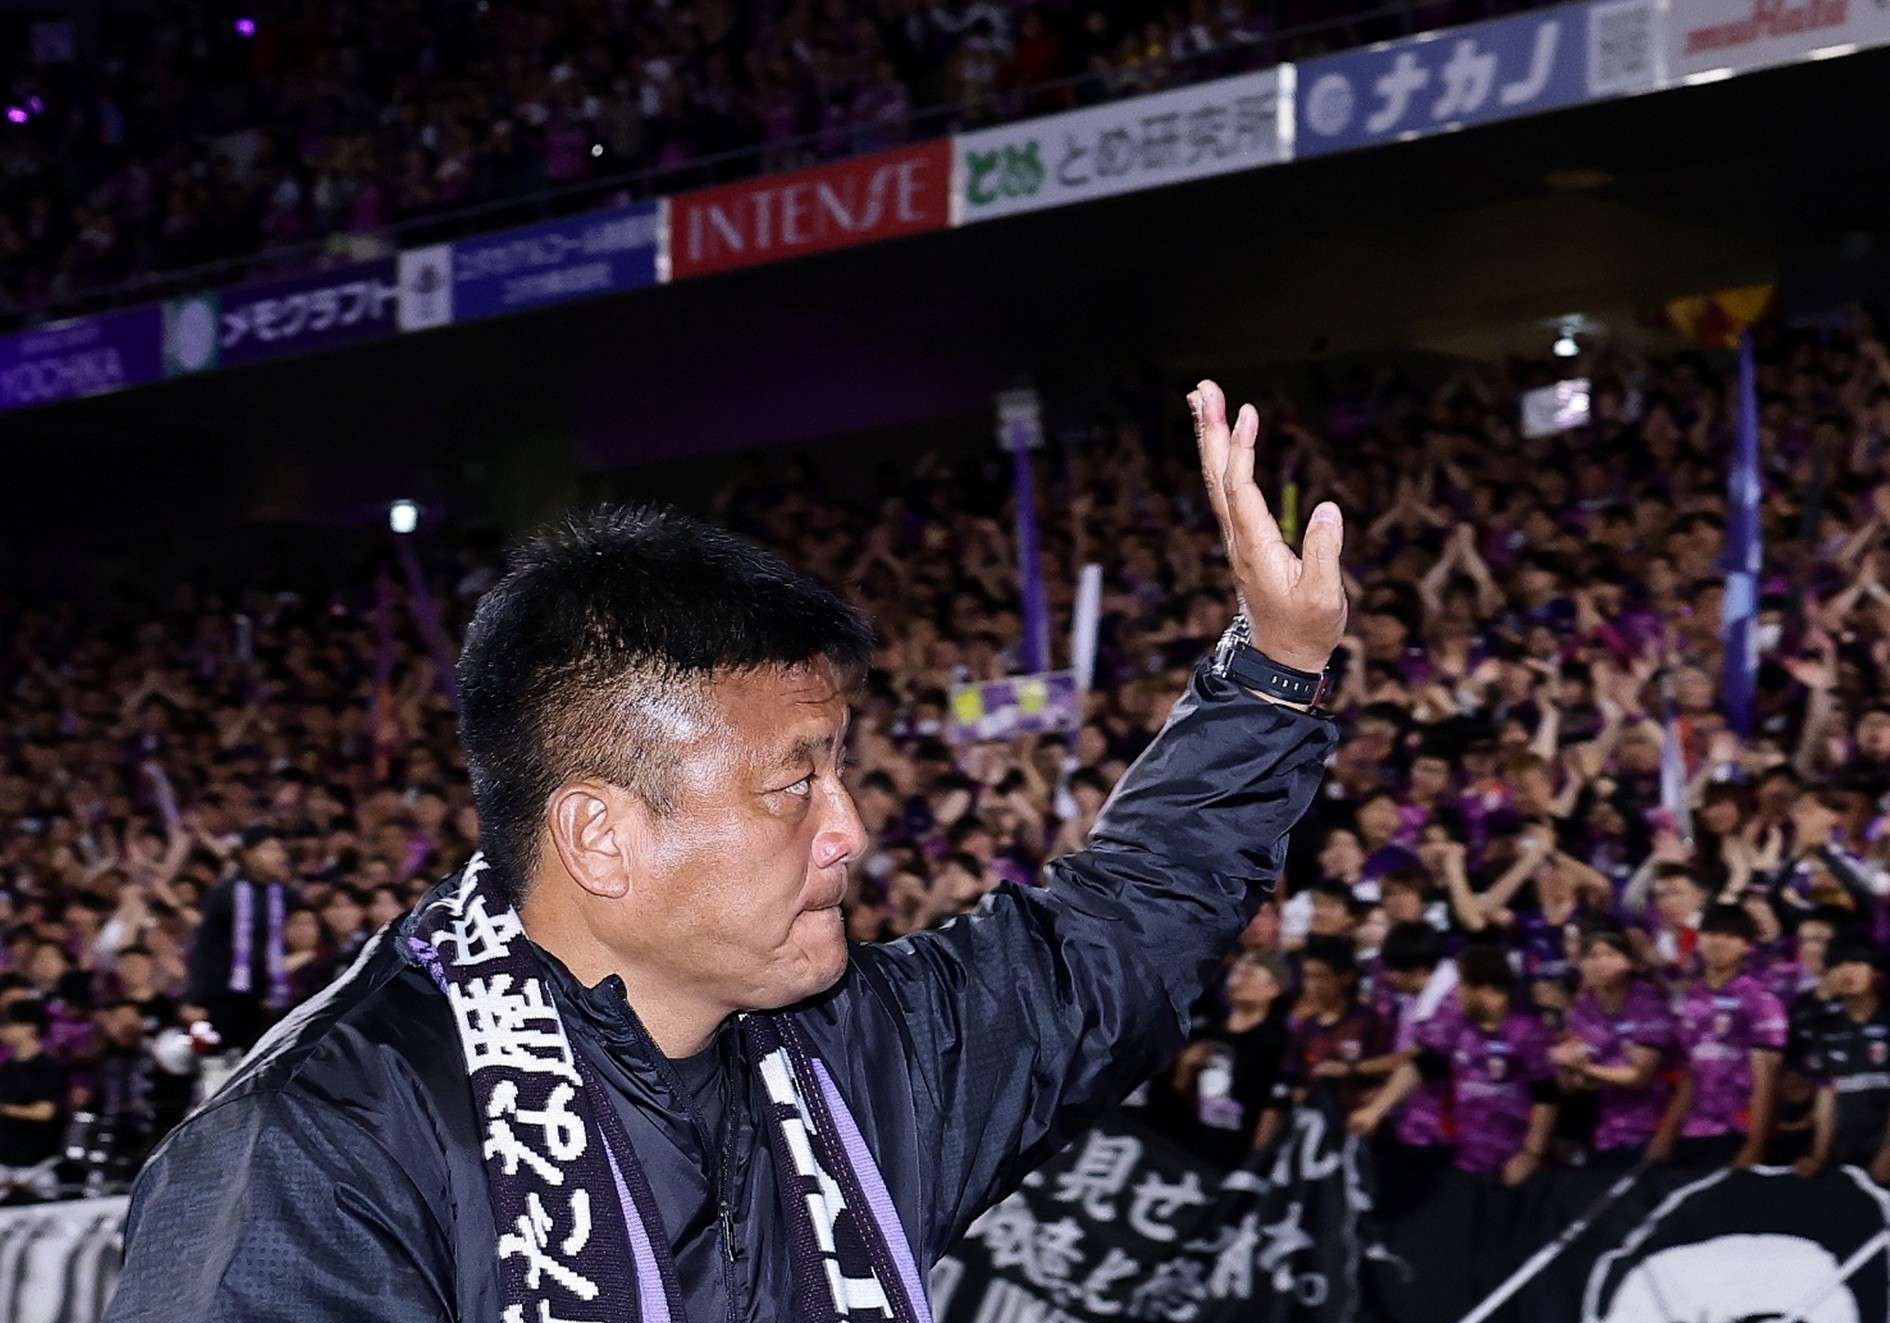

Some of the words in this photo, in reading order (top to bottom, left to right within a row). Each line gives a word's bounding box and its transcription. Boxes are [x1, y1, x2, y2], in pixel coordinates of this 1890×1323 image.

[1366, 20, 1561, 135] ナカノ
[687, 156, 932, 262] INTENSE
